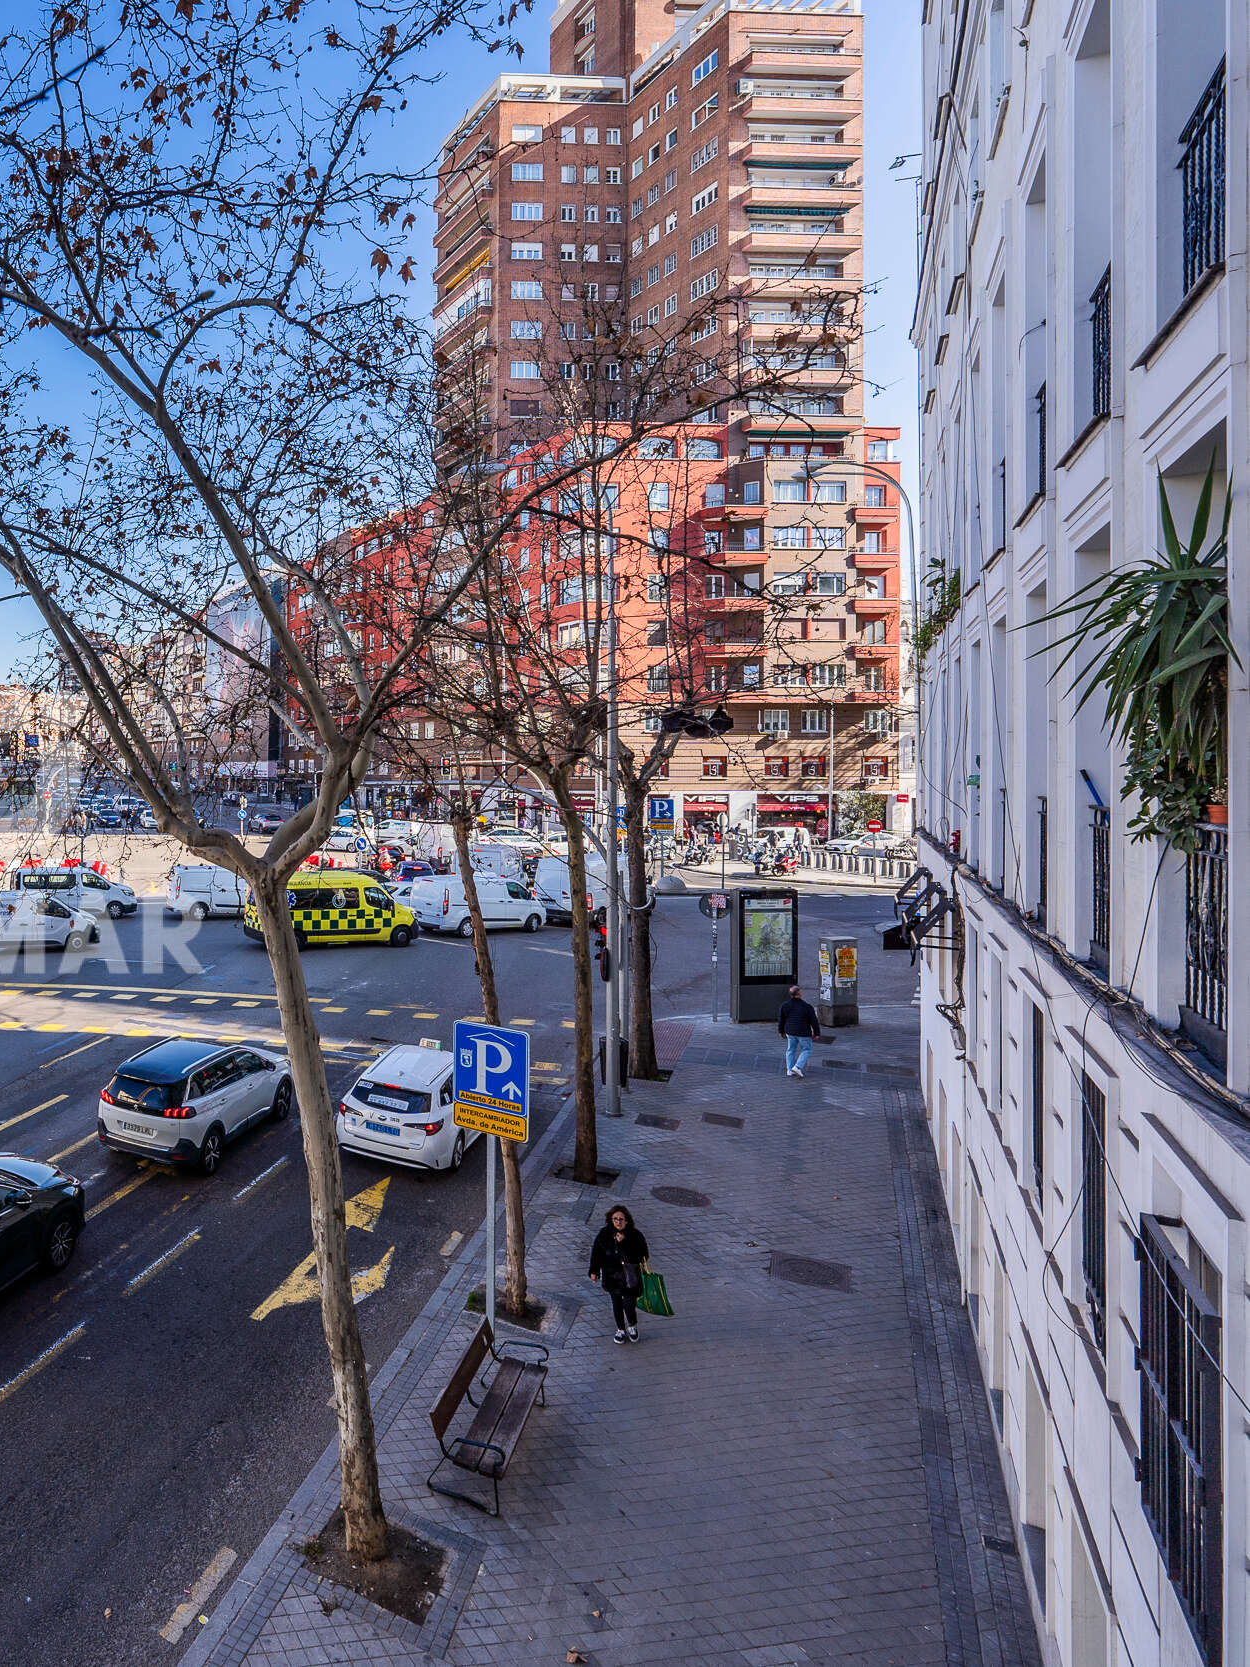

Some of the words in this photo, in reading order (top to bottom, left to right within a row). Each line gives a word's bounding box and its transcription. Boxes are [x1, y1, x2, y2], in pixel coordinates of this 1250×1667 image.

[683, 795, 728, 803] VIPS
[774, 795, 820, 803] VIPS
[653, 800, 669, 818] P
[469, 1037, 512, 1096] P
[460, 1092, 486, 1103] Abierto
[488, 1098, 497, 1106] 24
[498, 1100, 521, 1111] Horas
[457, 1115, 478, 1127] Avda.
[479, 1120, 489, 1128] de
[490, 1122, 524, 1138] América
[459, 1107, 521, 1127] INTERCAMBIADOR
